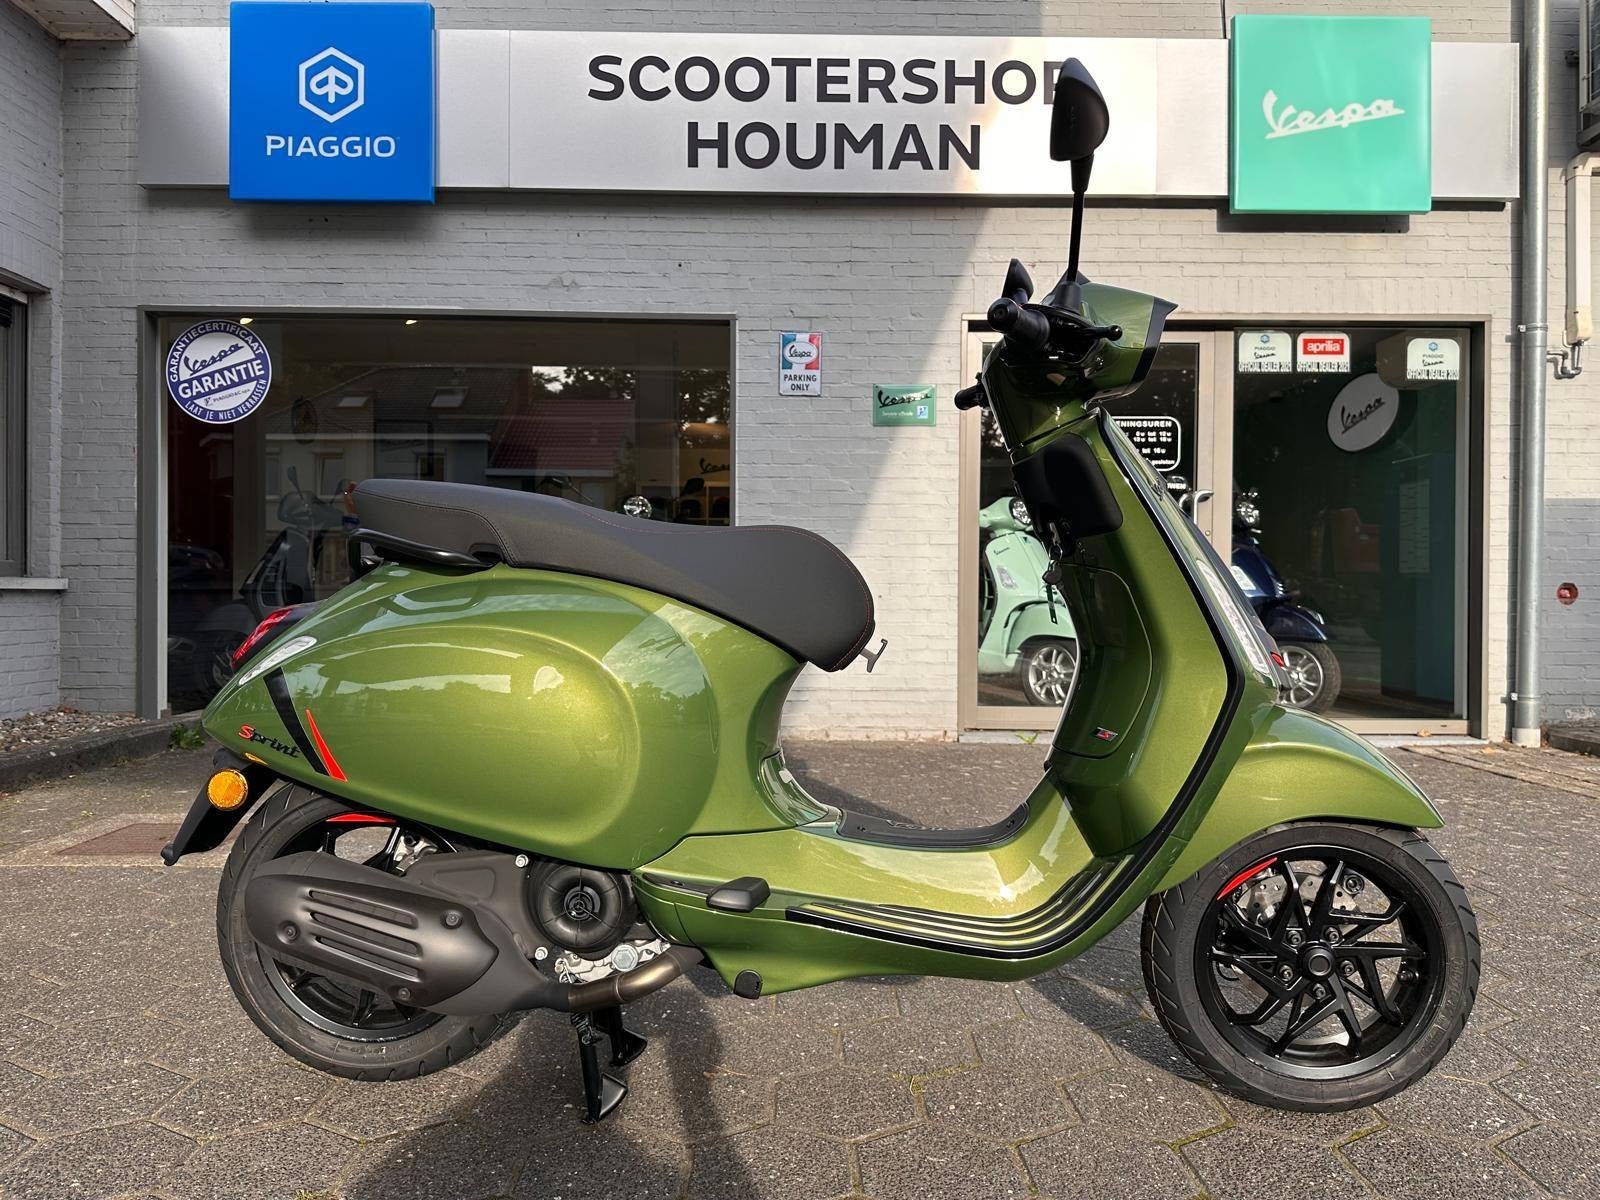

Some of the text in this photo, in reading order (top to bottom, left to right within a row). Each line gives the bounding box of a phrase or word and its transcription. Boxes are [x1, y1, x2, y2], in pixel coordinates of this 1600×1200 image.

[1262, 88, 1405, 139] Vespa
[266, 135, 396, 158] PIAGGIO
[687, 121, 981, 170] HOUMAN
[170, 322, 264, 382] GARANTIECERTIFICAAT
[183, 343, 245, 376] Vespa
[788, 344, 813, 358] Vespa
[1306, 340, 1340, 353] aprilia
[178, 360, 265, 399] GARANTIE
[790, 383, 810, 391] ONLY
[184, 379, 268, 420] LAAT JE NIET VERRASSEN
[1341, 396, 1386, 435] Vespa
[238, 724, 300, 758] Sprint
